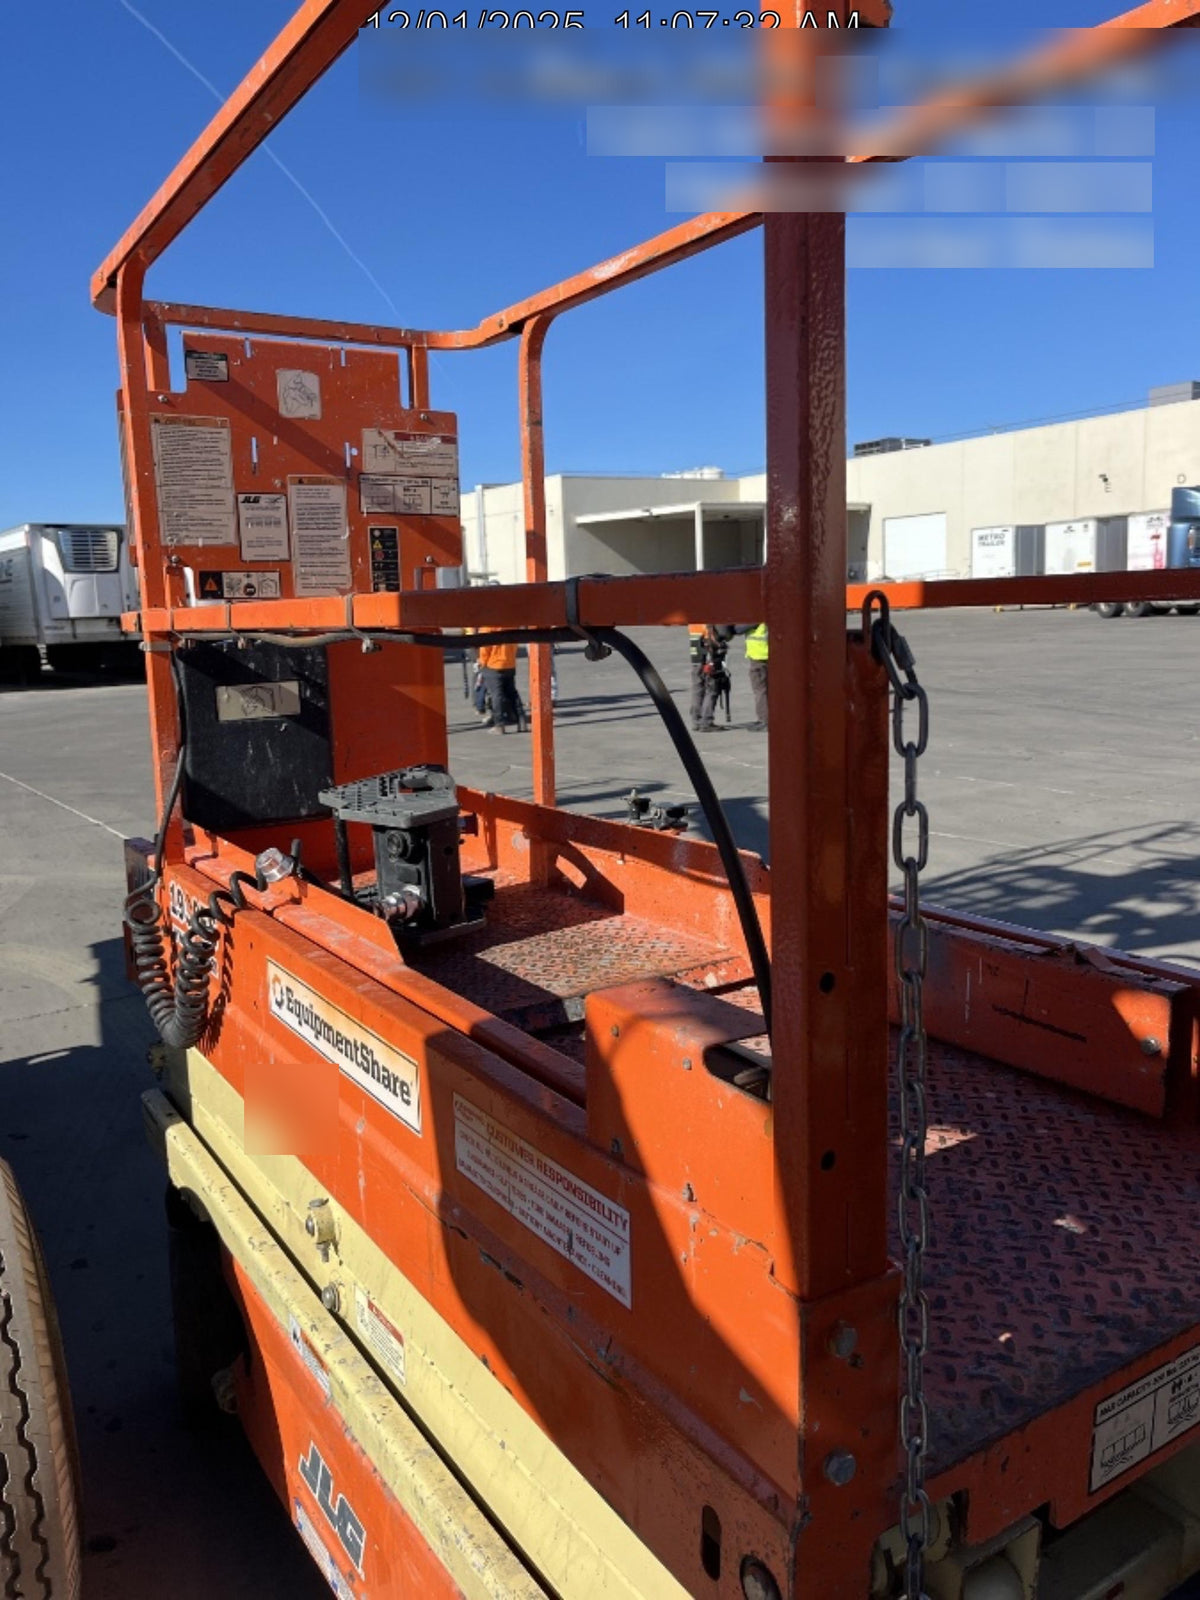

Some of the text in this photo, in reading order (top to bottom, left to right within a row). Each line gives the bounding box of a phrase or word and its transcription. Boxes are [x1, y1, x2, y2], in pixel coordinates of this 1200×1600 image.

[286, 985, 412, 1107] EquipmentShare
[486, 1122, 535, 1168] CUSTOMER
[536, 1158, 629, 1231] RESPONSIBILITY
